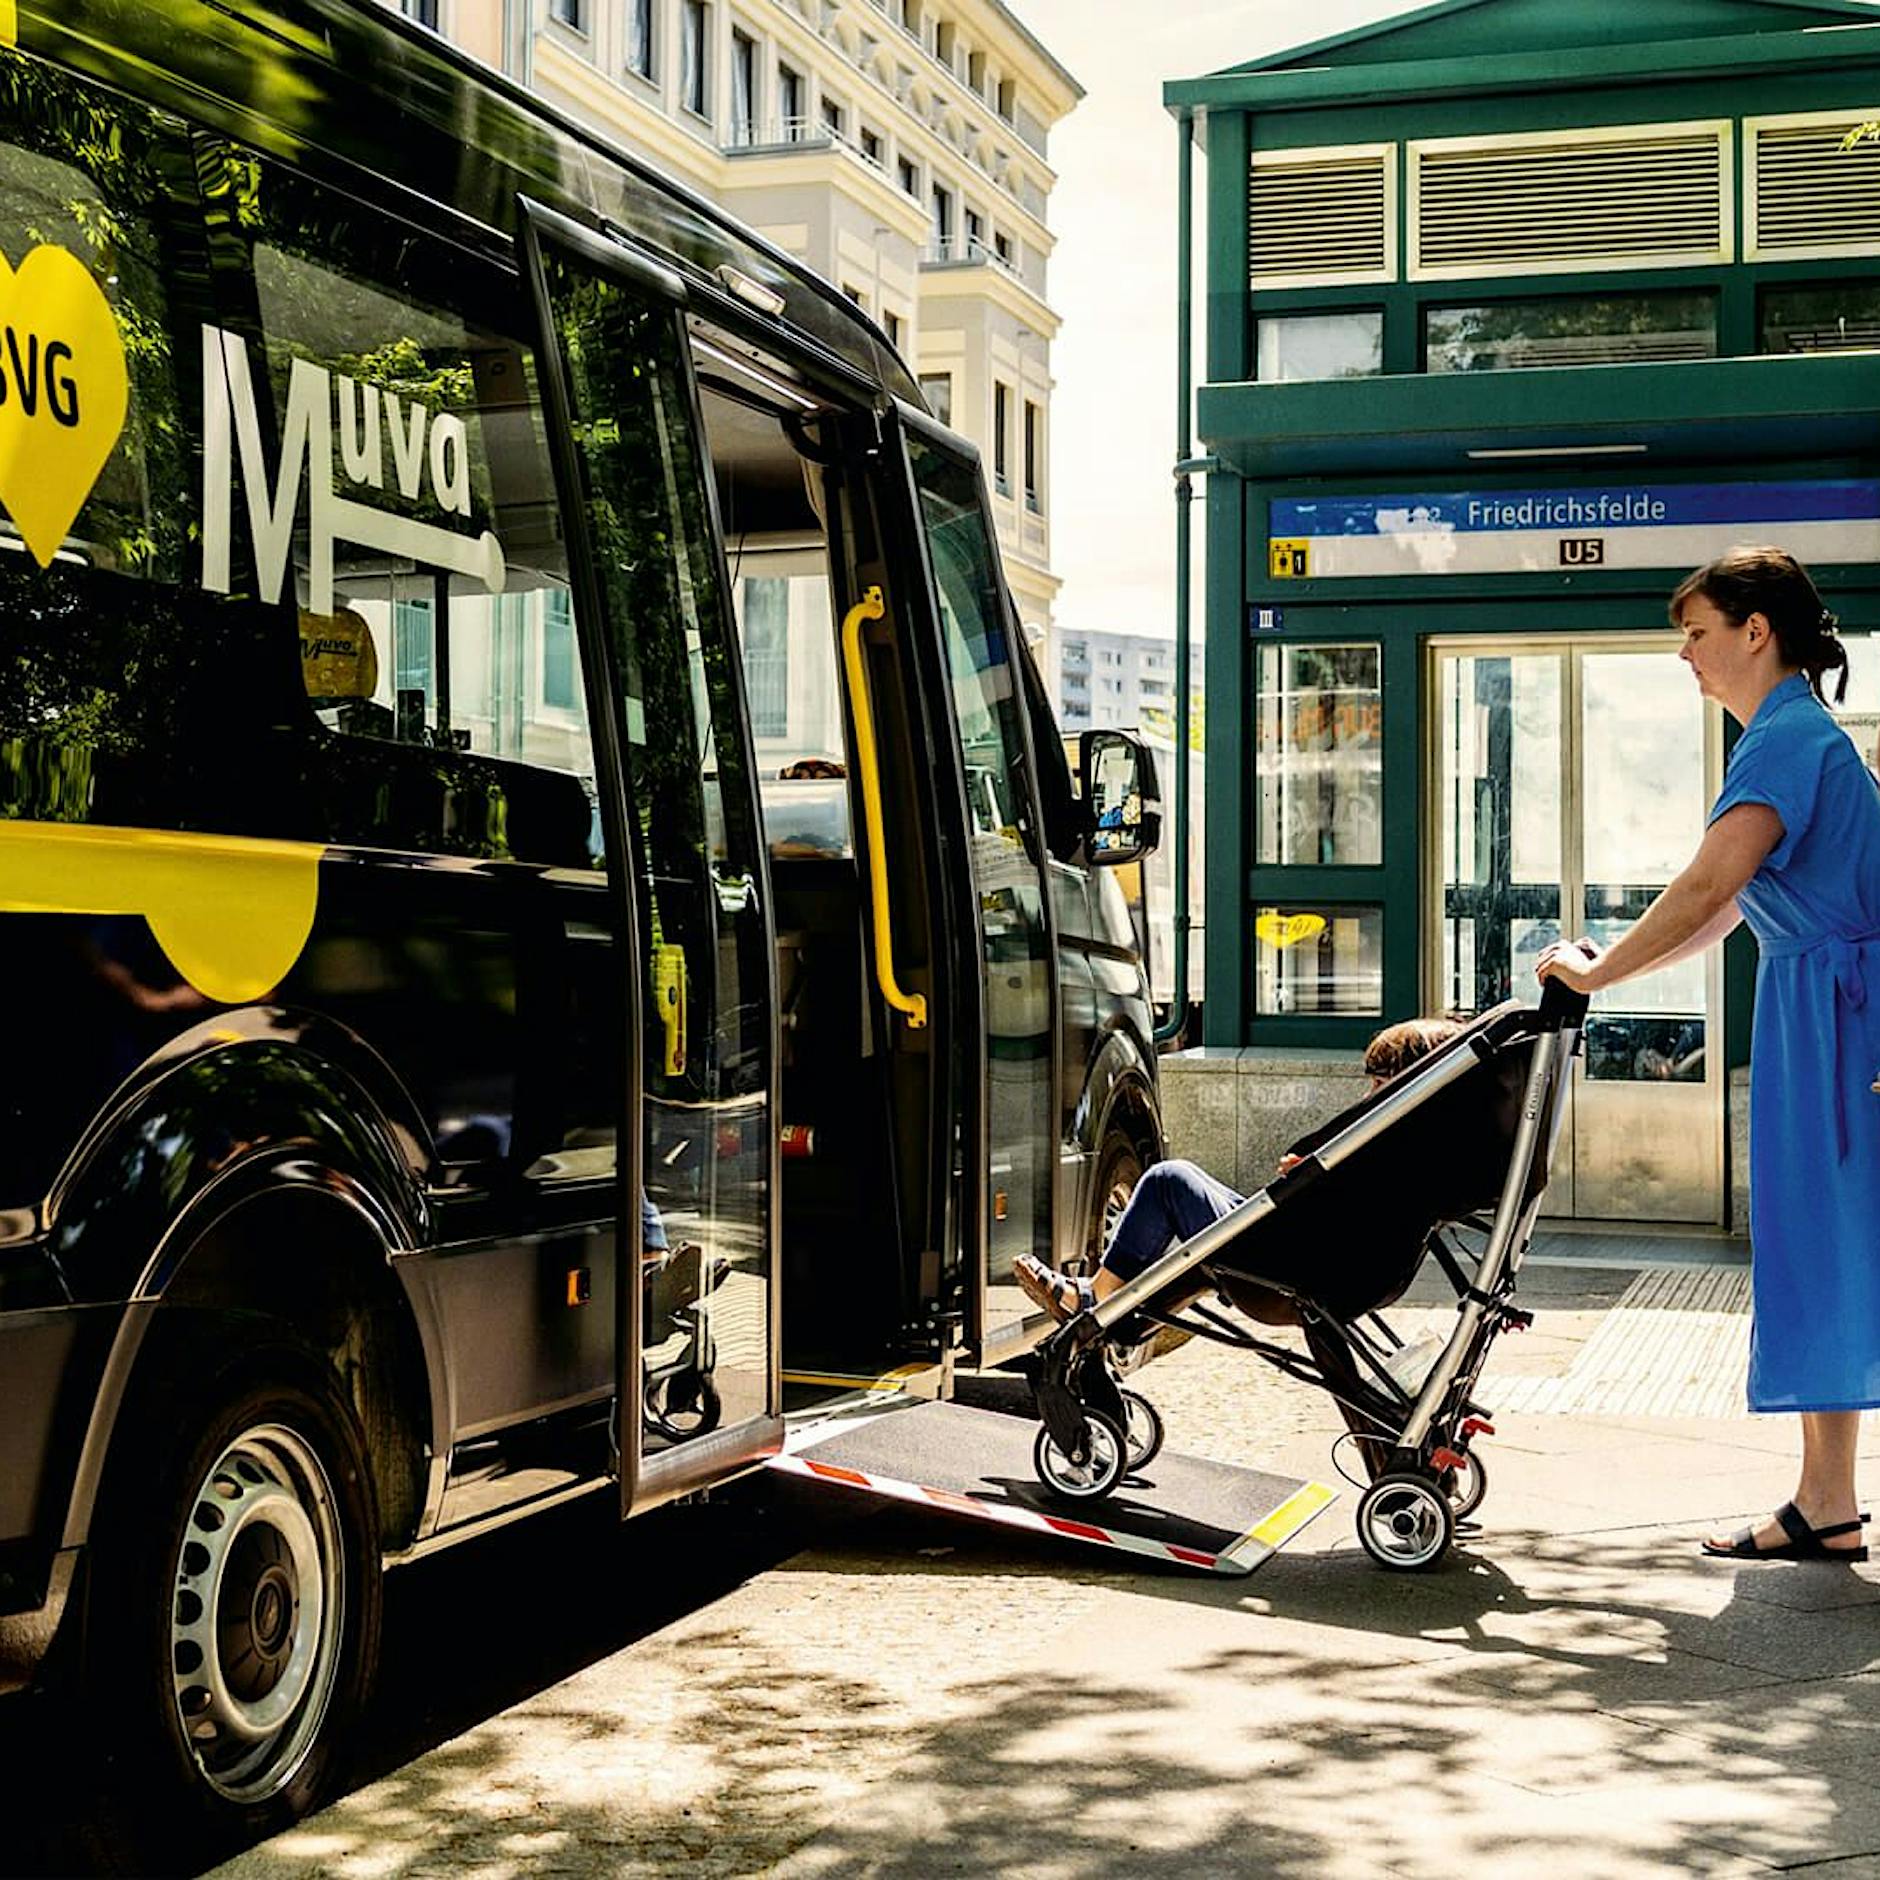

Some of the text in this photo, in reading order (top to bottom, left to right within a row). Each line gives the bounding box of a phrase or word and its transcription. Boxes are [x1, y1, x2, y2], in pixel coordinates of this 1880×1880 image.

[0, 326, 79, 427] VG
[201, 323, 505, 617] Muva
[1468, 494, 1665, 526] Friedrichsfelde
[1563, 540, 1601, 563] U5
